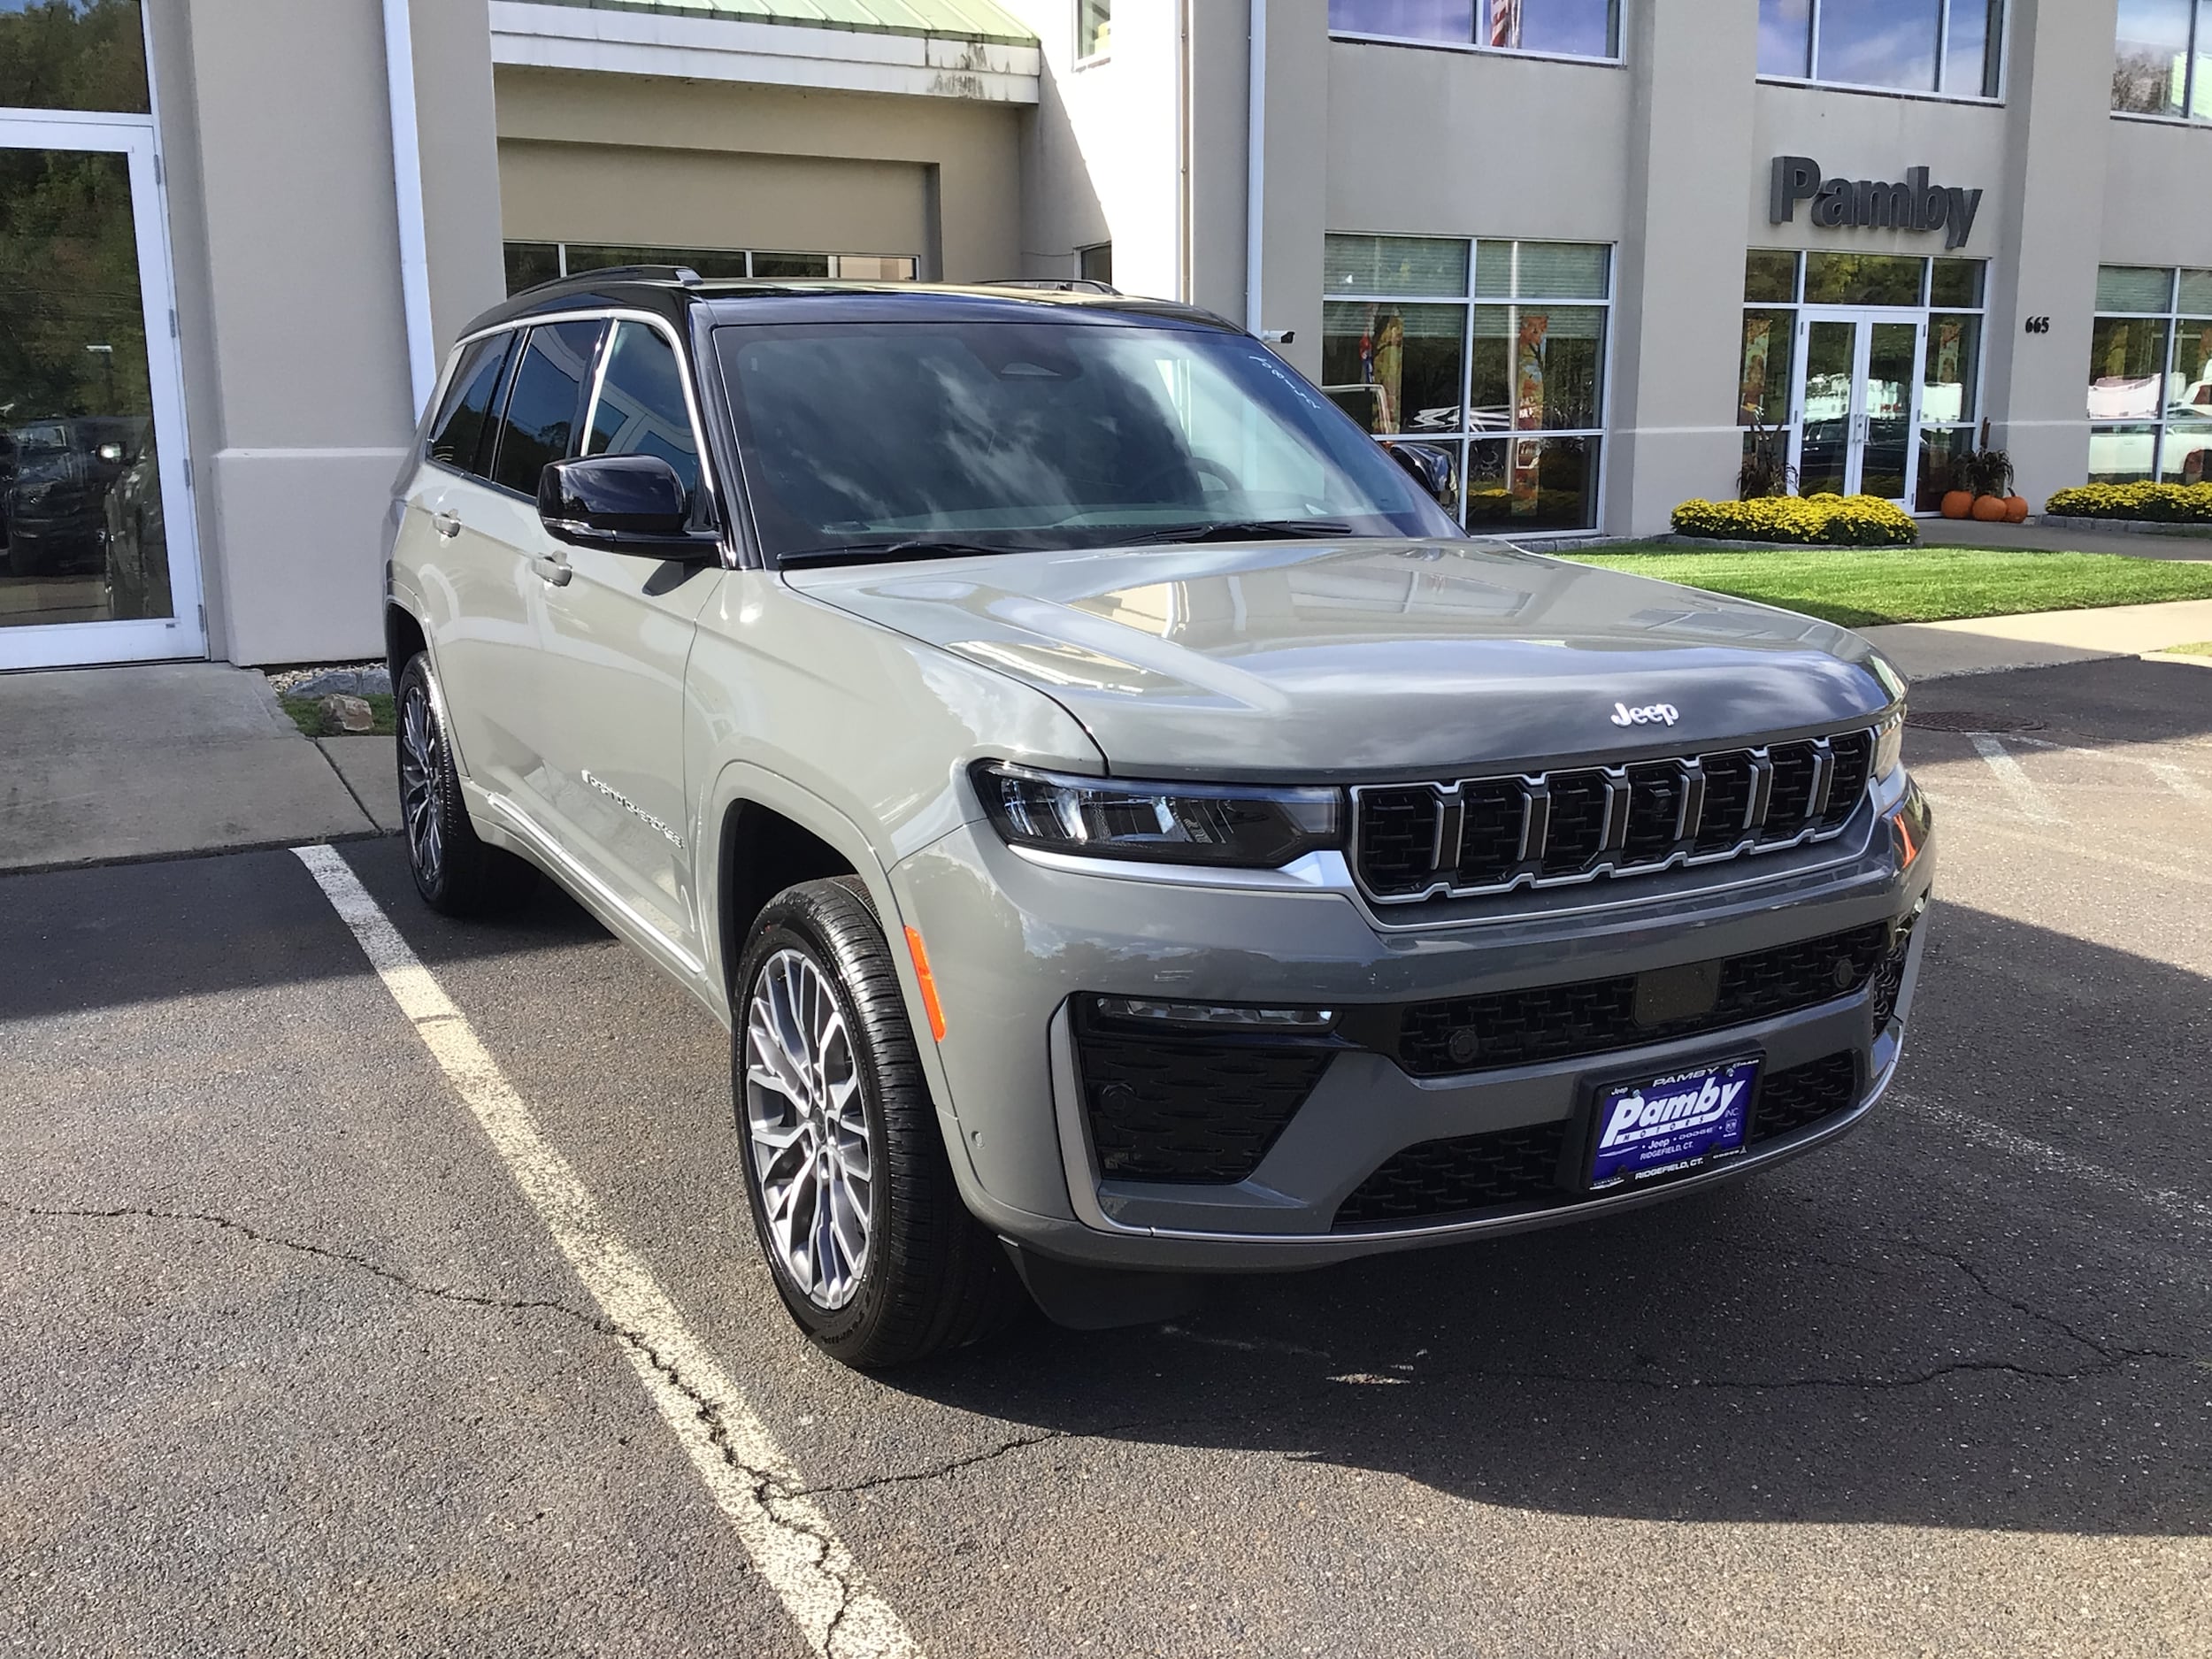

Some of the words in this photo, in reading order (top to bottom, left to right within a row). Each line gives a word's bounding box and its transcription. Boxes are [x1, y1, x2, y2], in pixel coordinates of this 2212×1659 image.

[1770, 156, 1984, 249] Pamby
[2025, 316, 2050, 334] 665
[1610, 703, 1679, 726] Jeep
[1652, 1066, 1719, 1087] PAMBY
[1611, 1087, 1629, 1095] Jeep
[1599, 1077, 1746, 1148] Pamby
[1623, 1116, 1704, 1141] MOTORS
[1647, 1138, 1671, 1149] Jeep
[1678, 1126, 1714, 1141] DODGE
[1634, 1161, 1689, 1180] RIDGEFIELD,
[1690, 1157, 1704, 1167] CT.
